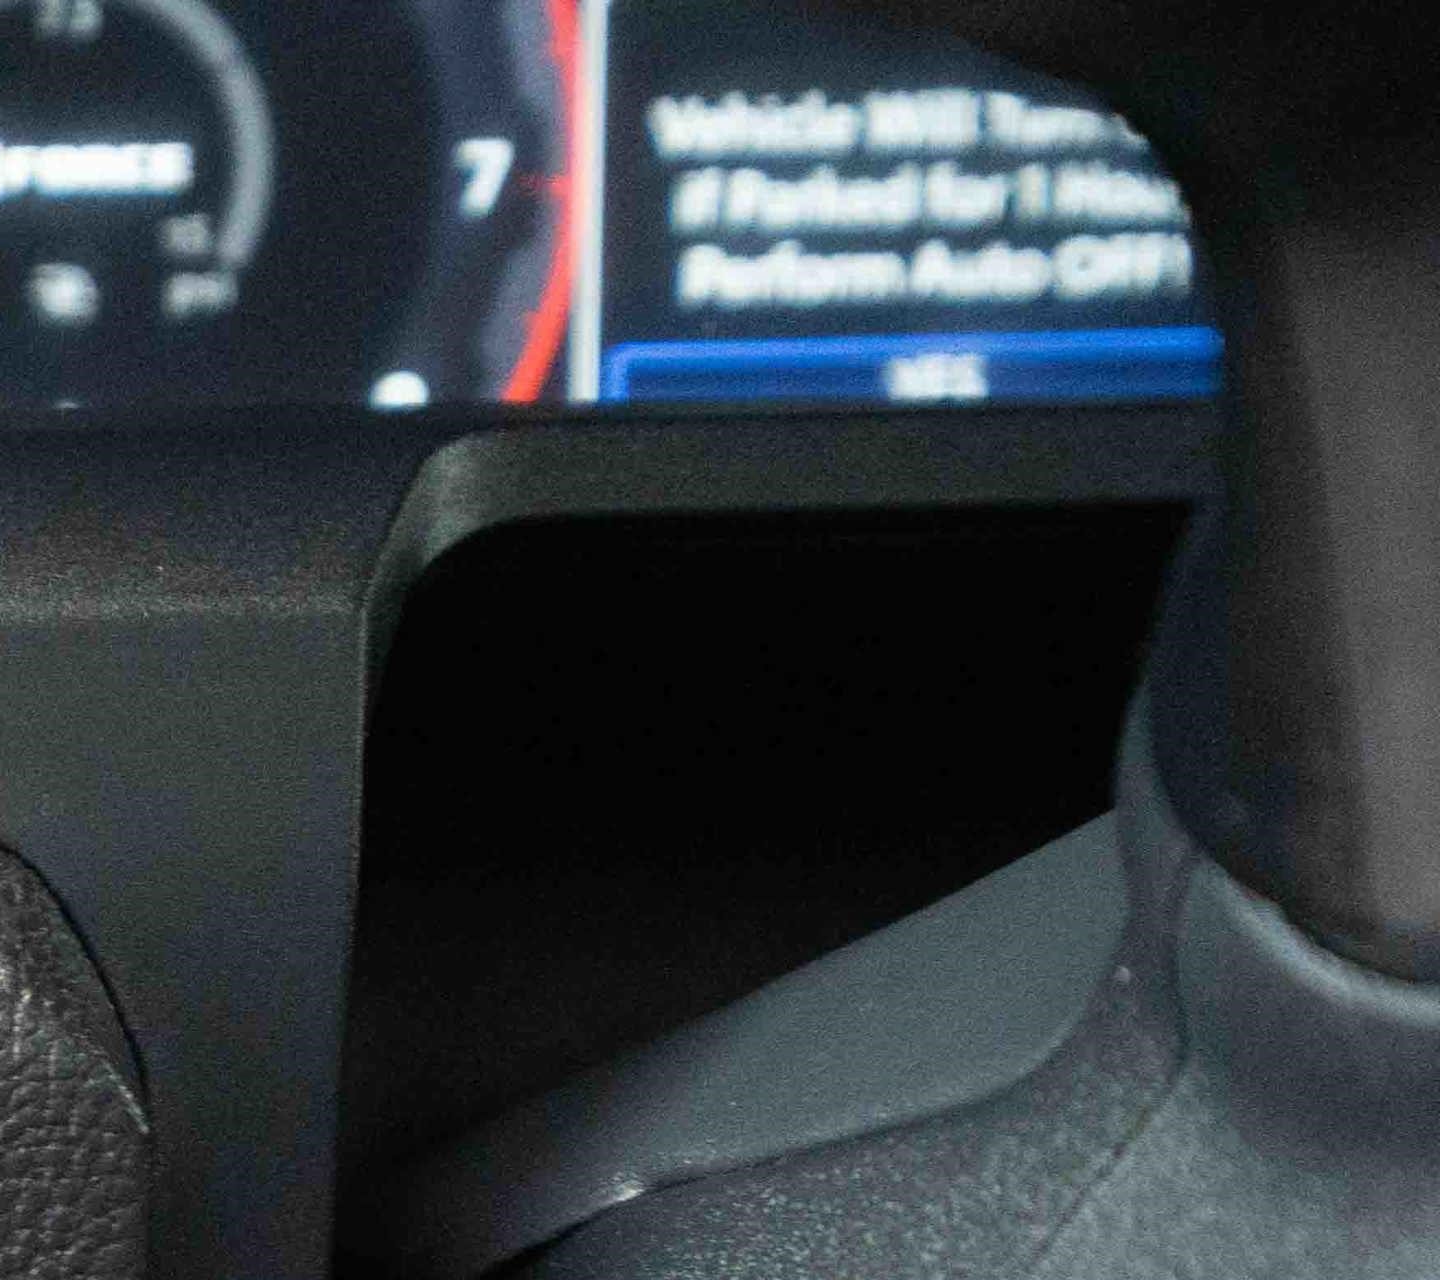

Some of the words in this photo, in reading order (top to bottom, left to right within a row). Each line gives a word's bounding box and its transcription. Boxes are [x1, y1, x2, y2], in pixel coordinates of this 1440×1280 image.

[648, 89, 860, 158] Vehicle
[454, 136, 515, 218] 7
[723, 162, 920, 231] Parked
[924, 161, 1008, 228] for
[677, 239, 907, 307] Perform
[910, 239, 1051, 299] Auto
